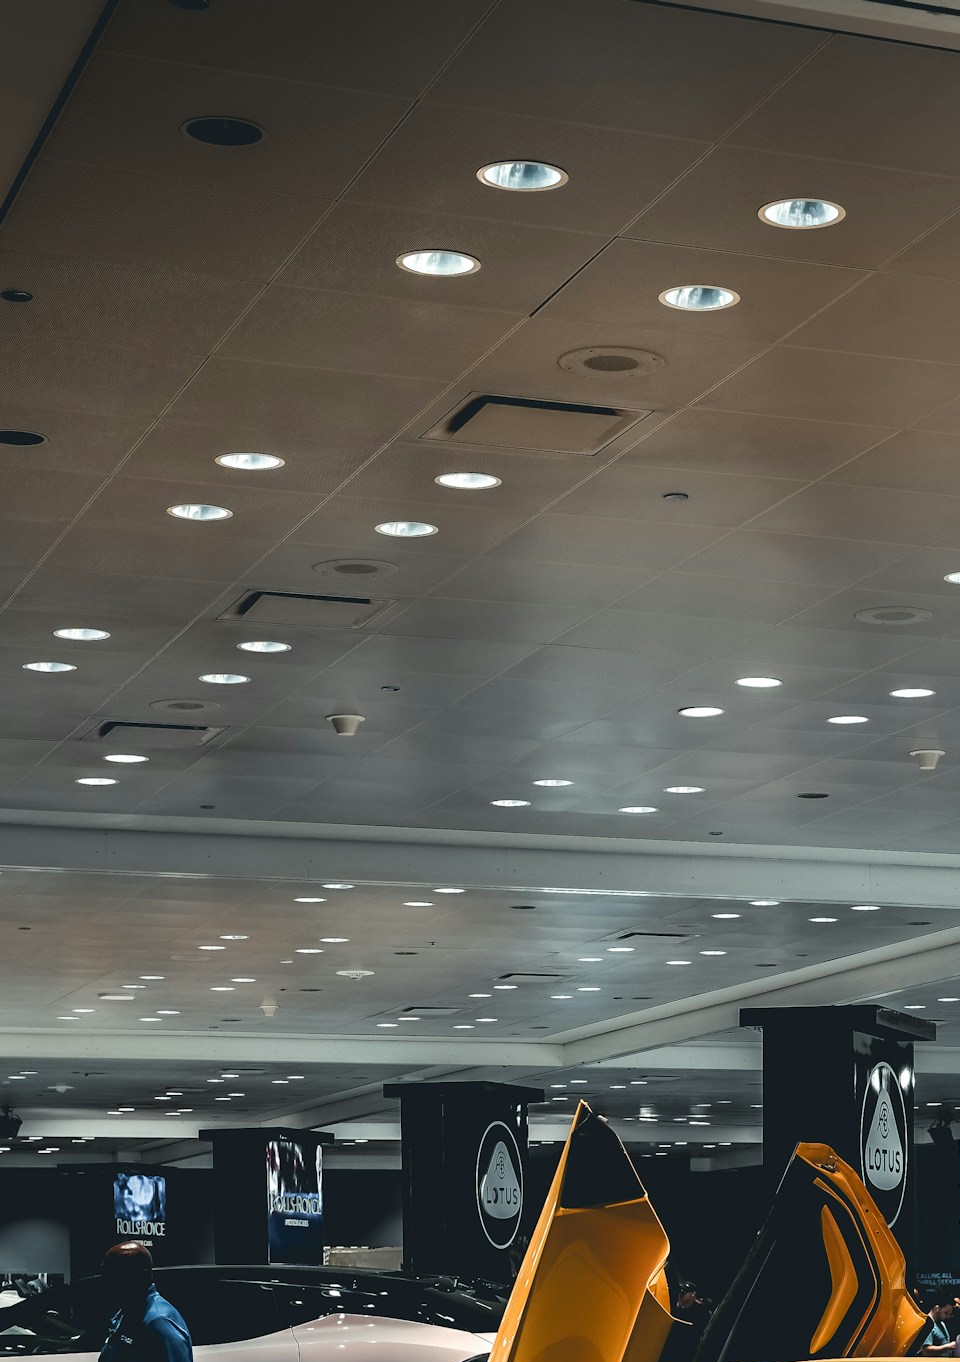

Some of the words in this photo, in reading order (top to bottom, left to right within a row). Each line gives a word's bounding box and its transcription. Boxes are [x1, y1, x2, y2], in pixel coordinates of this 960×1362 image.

[868, 1147, 901, 1174] LOTUS
[486, 1186, 518, 1205] LOTUS
[116, 1218, 166, 1236] ROLLS-ROYCE
